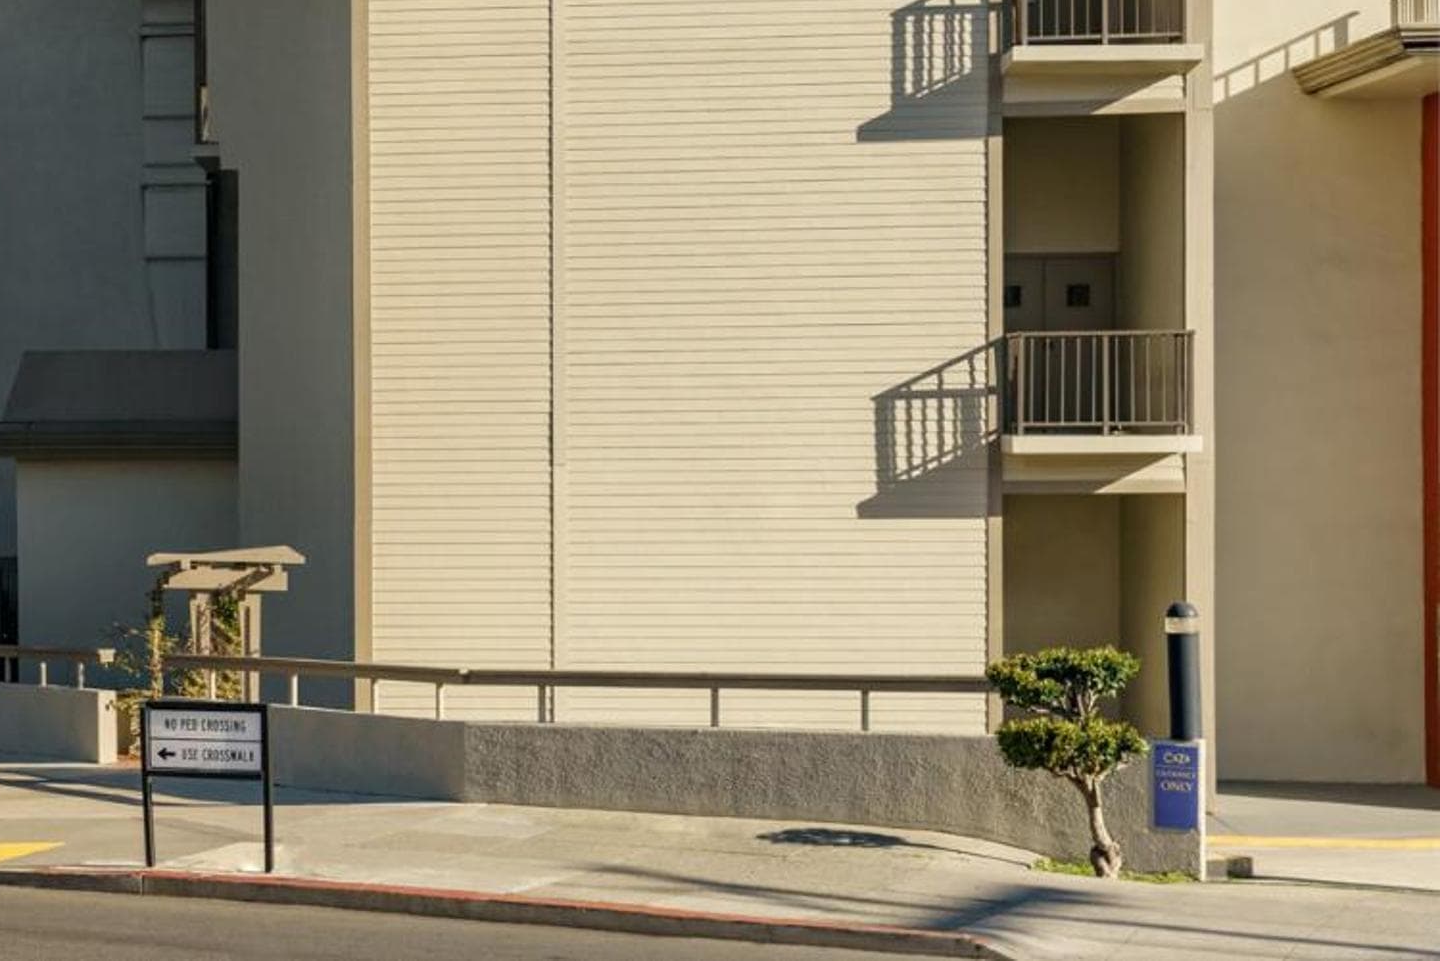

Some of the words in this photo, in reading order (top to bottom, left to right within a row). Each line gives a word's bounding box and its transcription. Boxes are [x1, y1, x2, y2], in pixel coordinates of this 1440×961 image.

[164, 718, 177, 731] NO
[180, 718, 198, 731] PED
[201, 719, 247, 733] CROSSING
[182, 748, 198, 760] USE
[201, 749, 254, 762] CROSSWALK
[1160, 780, 1192, 791] ONLY
